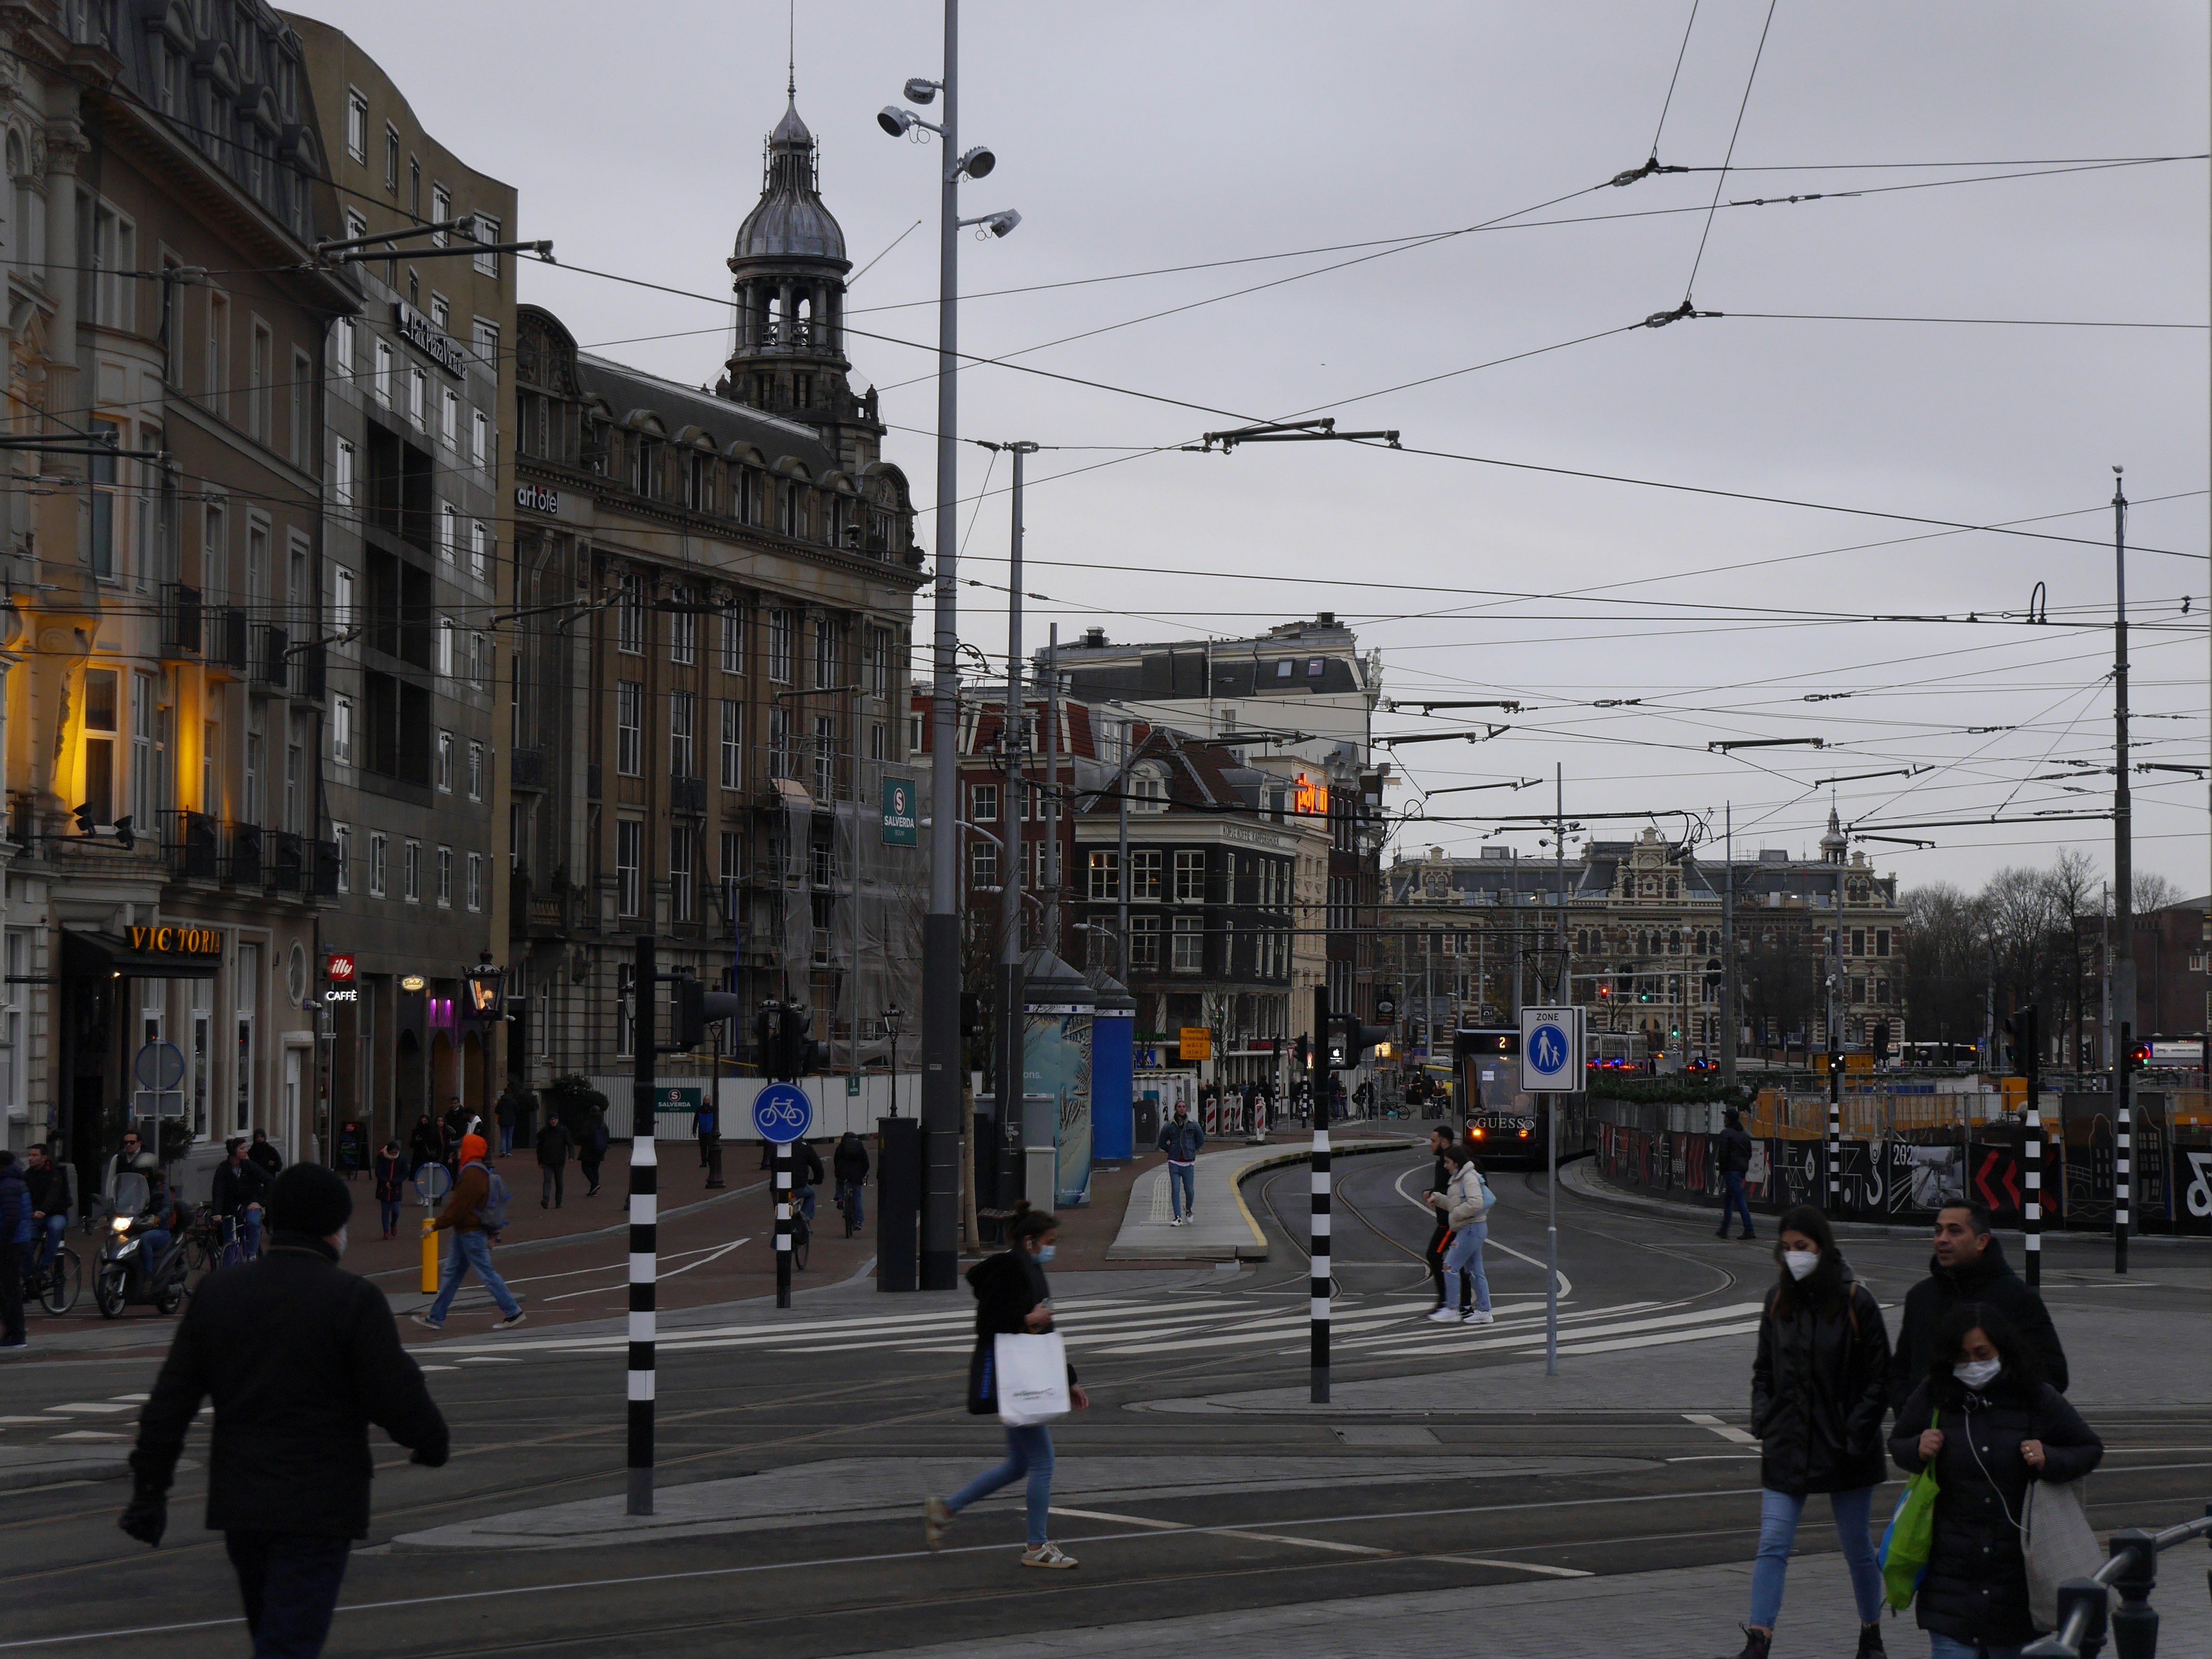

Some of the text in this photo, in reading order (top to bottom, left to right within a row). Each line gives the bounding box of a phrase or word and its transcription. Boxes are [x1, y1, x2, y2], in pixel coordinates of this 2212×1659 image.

[411, 313, 467, 380] Park Plaza Victoria
[896, 792, 903, 811] S
[884, 815, 915, 828] SALVERDA
[132, 926, 221, 954] VICTORIA
[331, 959, 353, 978] illy
[326, 989, 358, 1001] CAFFÈ
[1499, 1036, 1506, 1048] 2
[1477, 1118, 1524, 1129] GUESS
